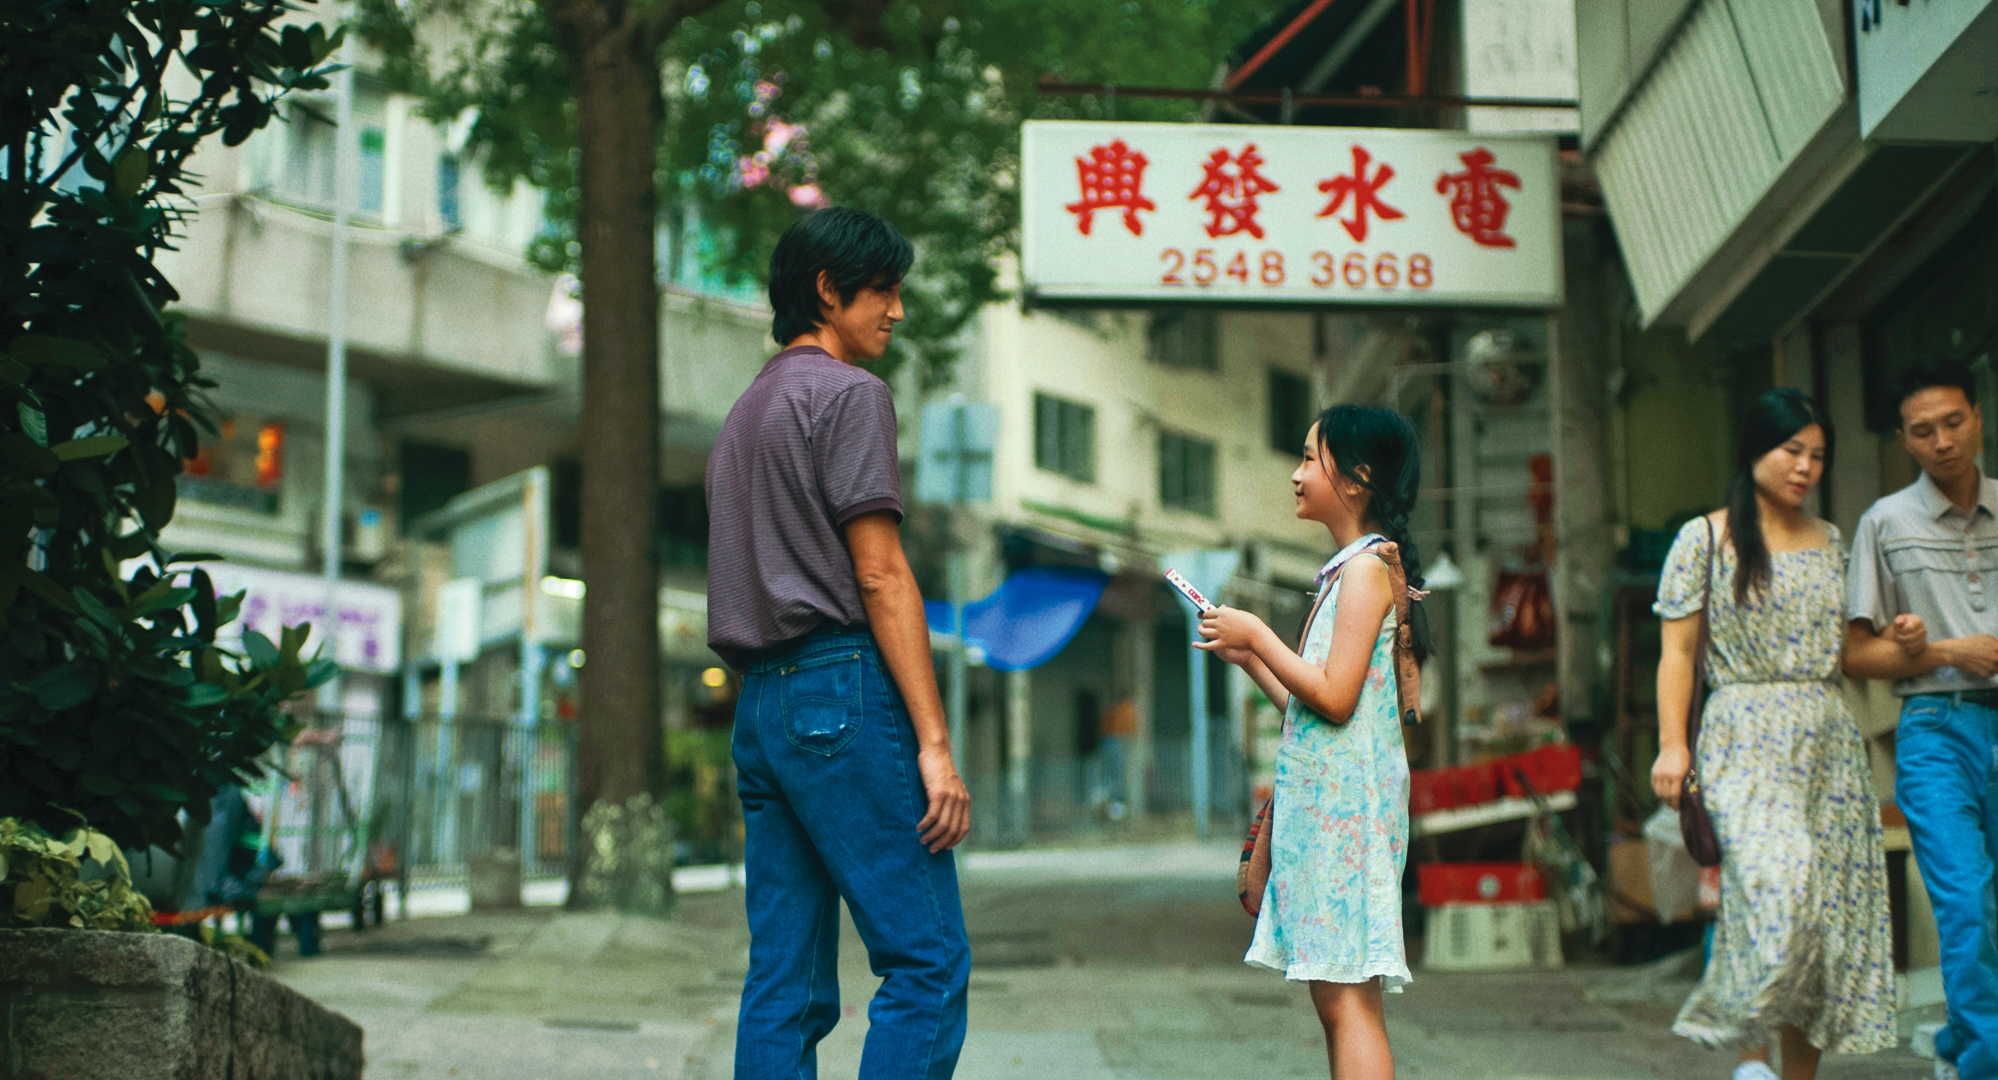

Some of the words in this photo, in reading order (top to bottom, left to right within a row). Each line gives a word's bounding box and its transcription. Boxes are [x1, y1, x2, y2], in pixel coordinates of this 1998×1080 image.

[1065, 138, 1522, 249] 興發水電
[1160, 249, 1286, 286] 2548
[1311, 252, 1434, 289] 3668
